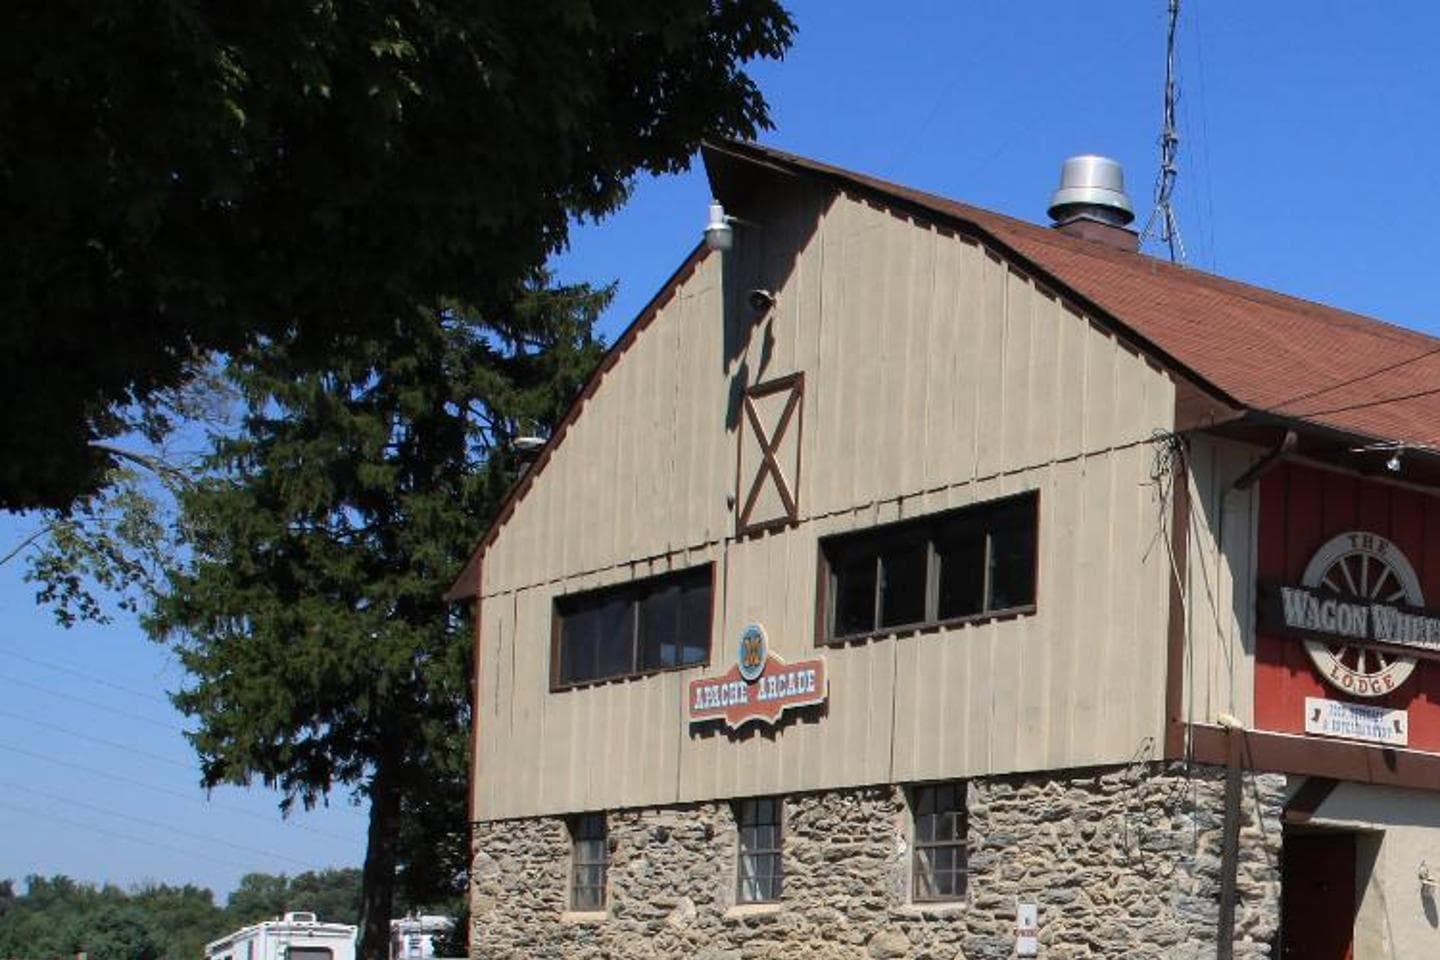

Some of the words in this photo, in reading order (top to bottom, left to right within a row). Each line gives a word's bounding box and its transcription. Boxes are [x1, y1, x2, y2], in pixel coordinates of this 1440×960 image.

[1349, 533, 1390, 554] THE
[1281, 586, 1369, 638] WAGON
[694, 681, 748, 710] APACHE
[757, 669, 816, 700] ARCADE
[1331, 666, 1395, 694] LODGE
